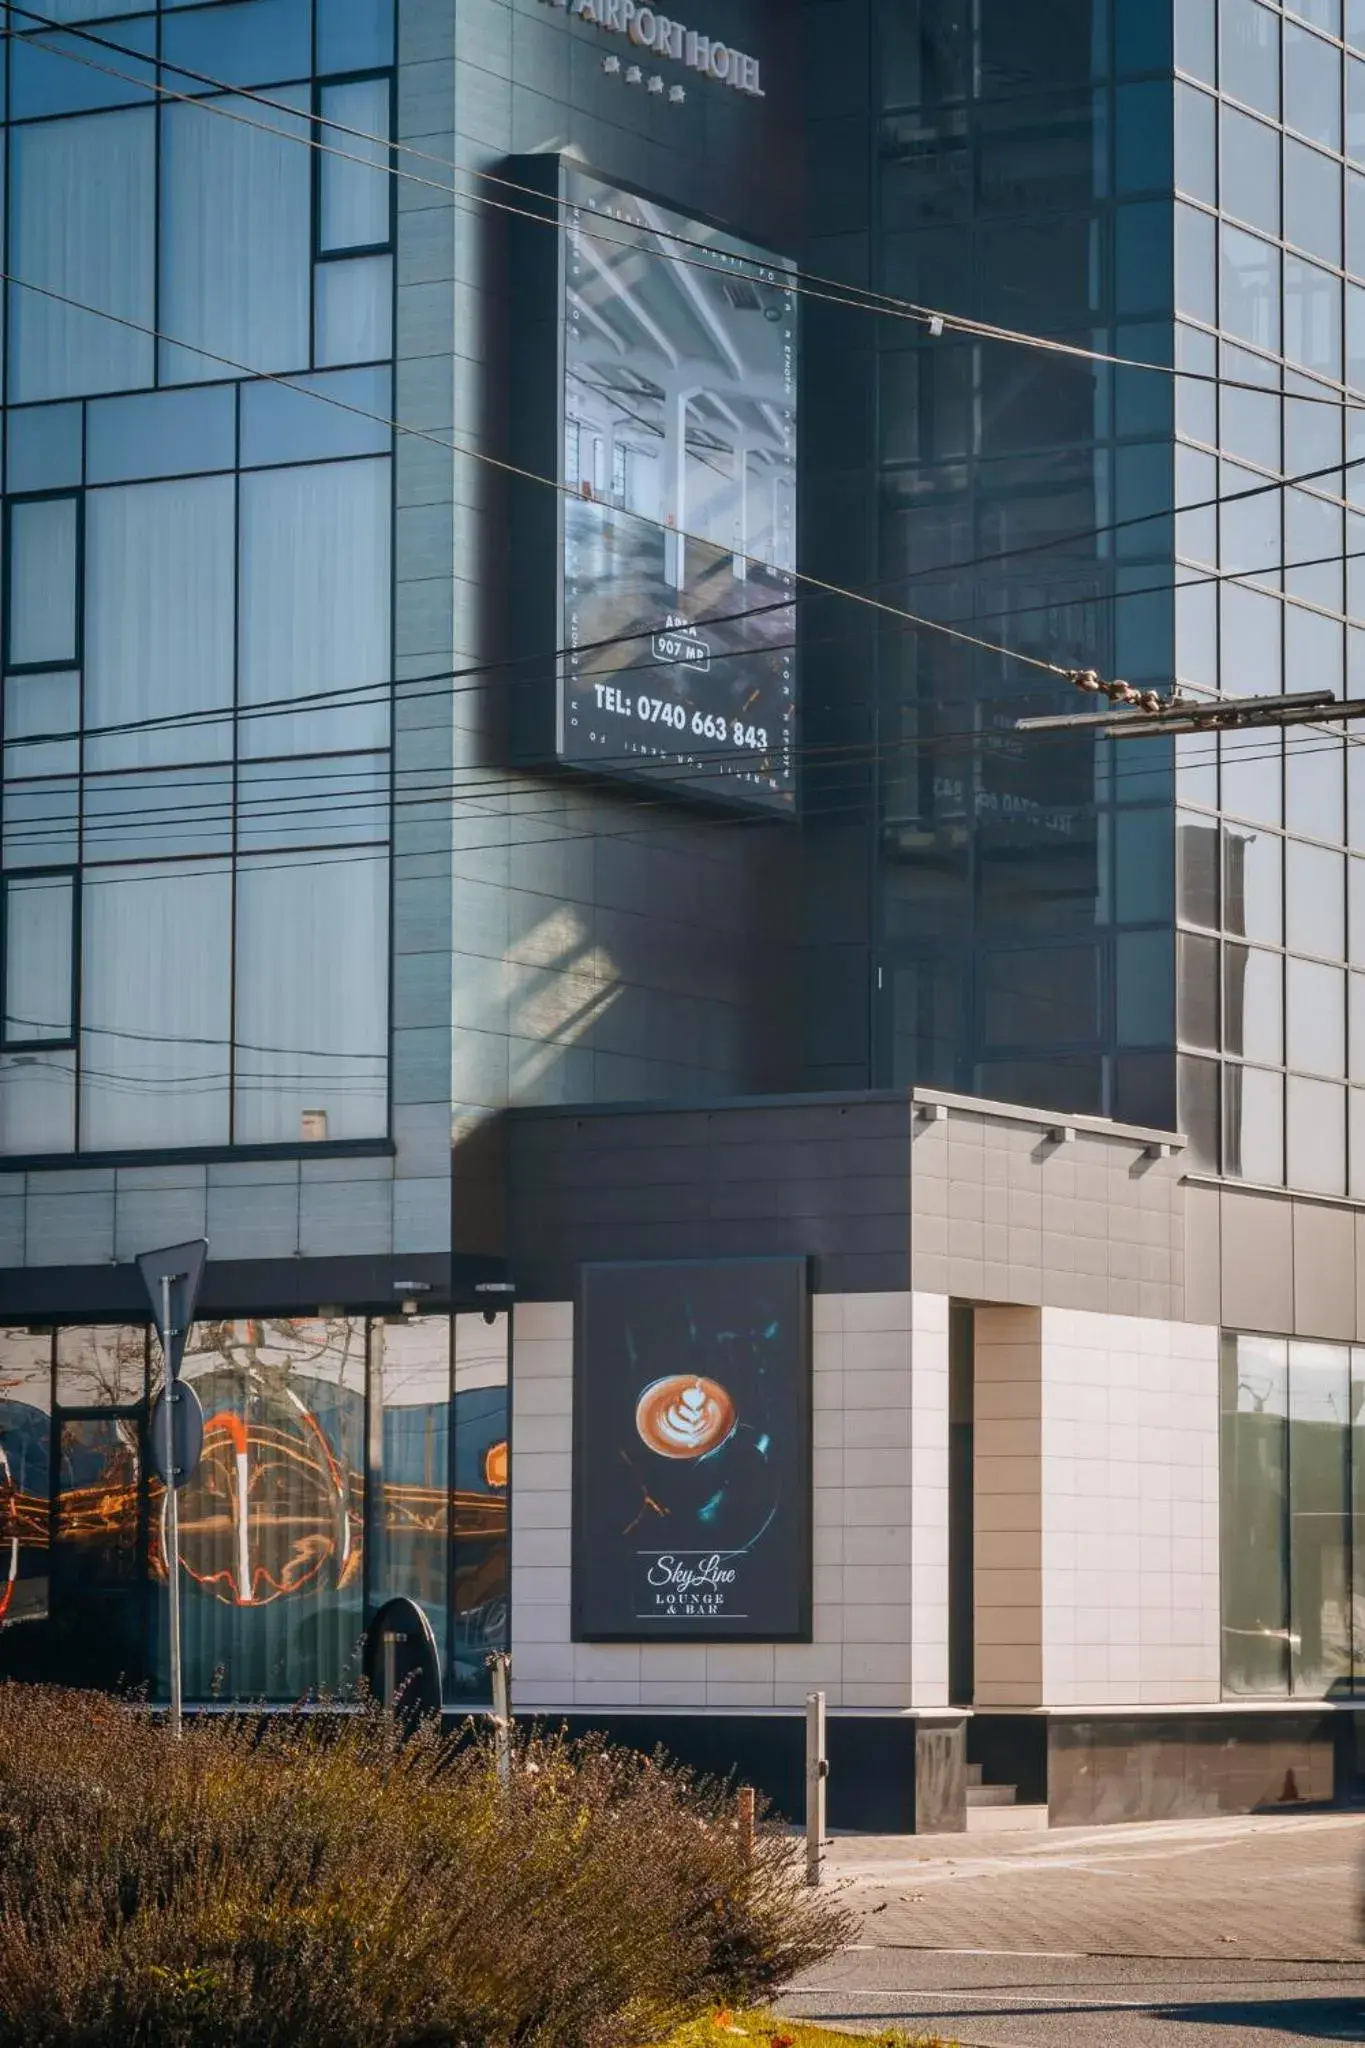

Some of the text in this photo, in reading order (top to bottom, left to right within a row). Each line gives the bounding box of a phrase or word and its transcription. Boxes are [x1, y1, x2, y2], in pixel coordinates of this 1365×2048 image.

[686, 30, 765, 96] HOTEL
[658, 637, 681, 656] 907
[594, 683, 632, 716] TEL:
[637, 696, 686, 730] 0740
[691, 711, 727, 741] 663
[733, 722, 768, 752] 843
[655, 1593, 725, 1605] LOUNGE
[666, 1604, 719, 1615] & BAR
